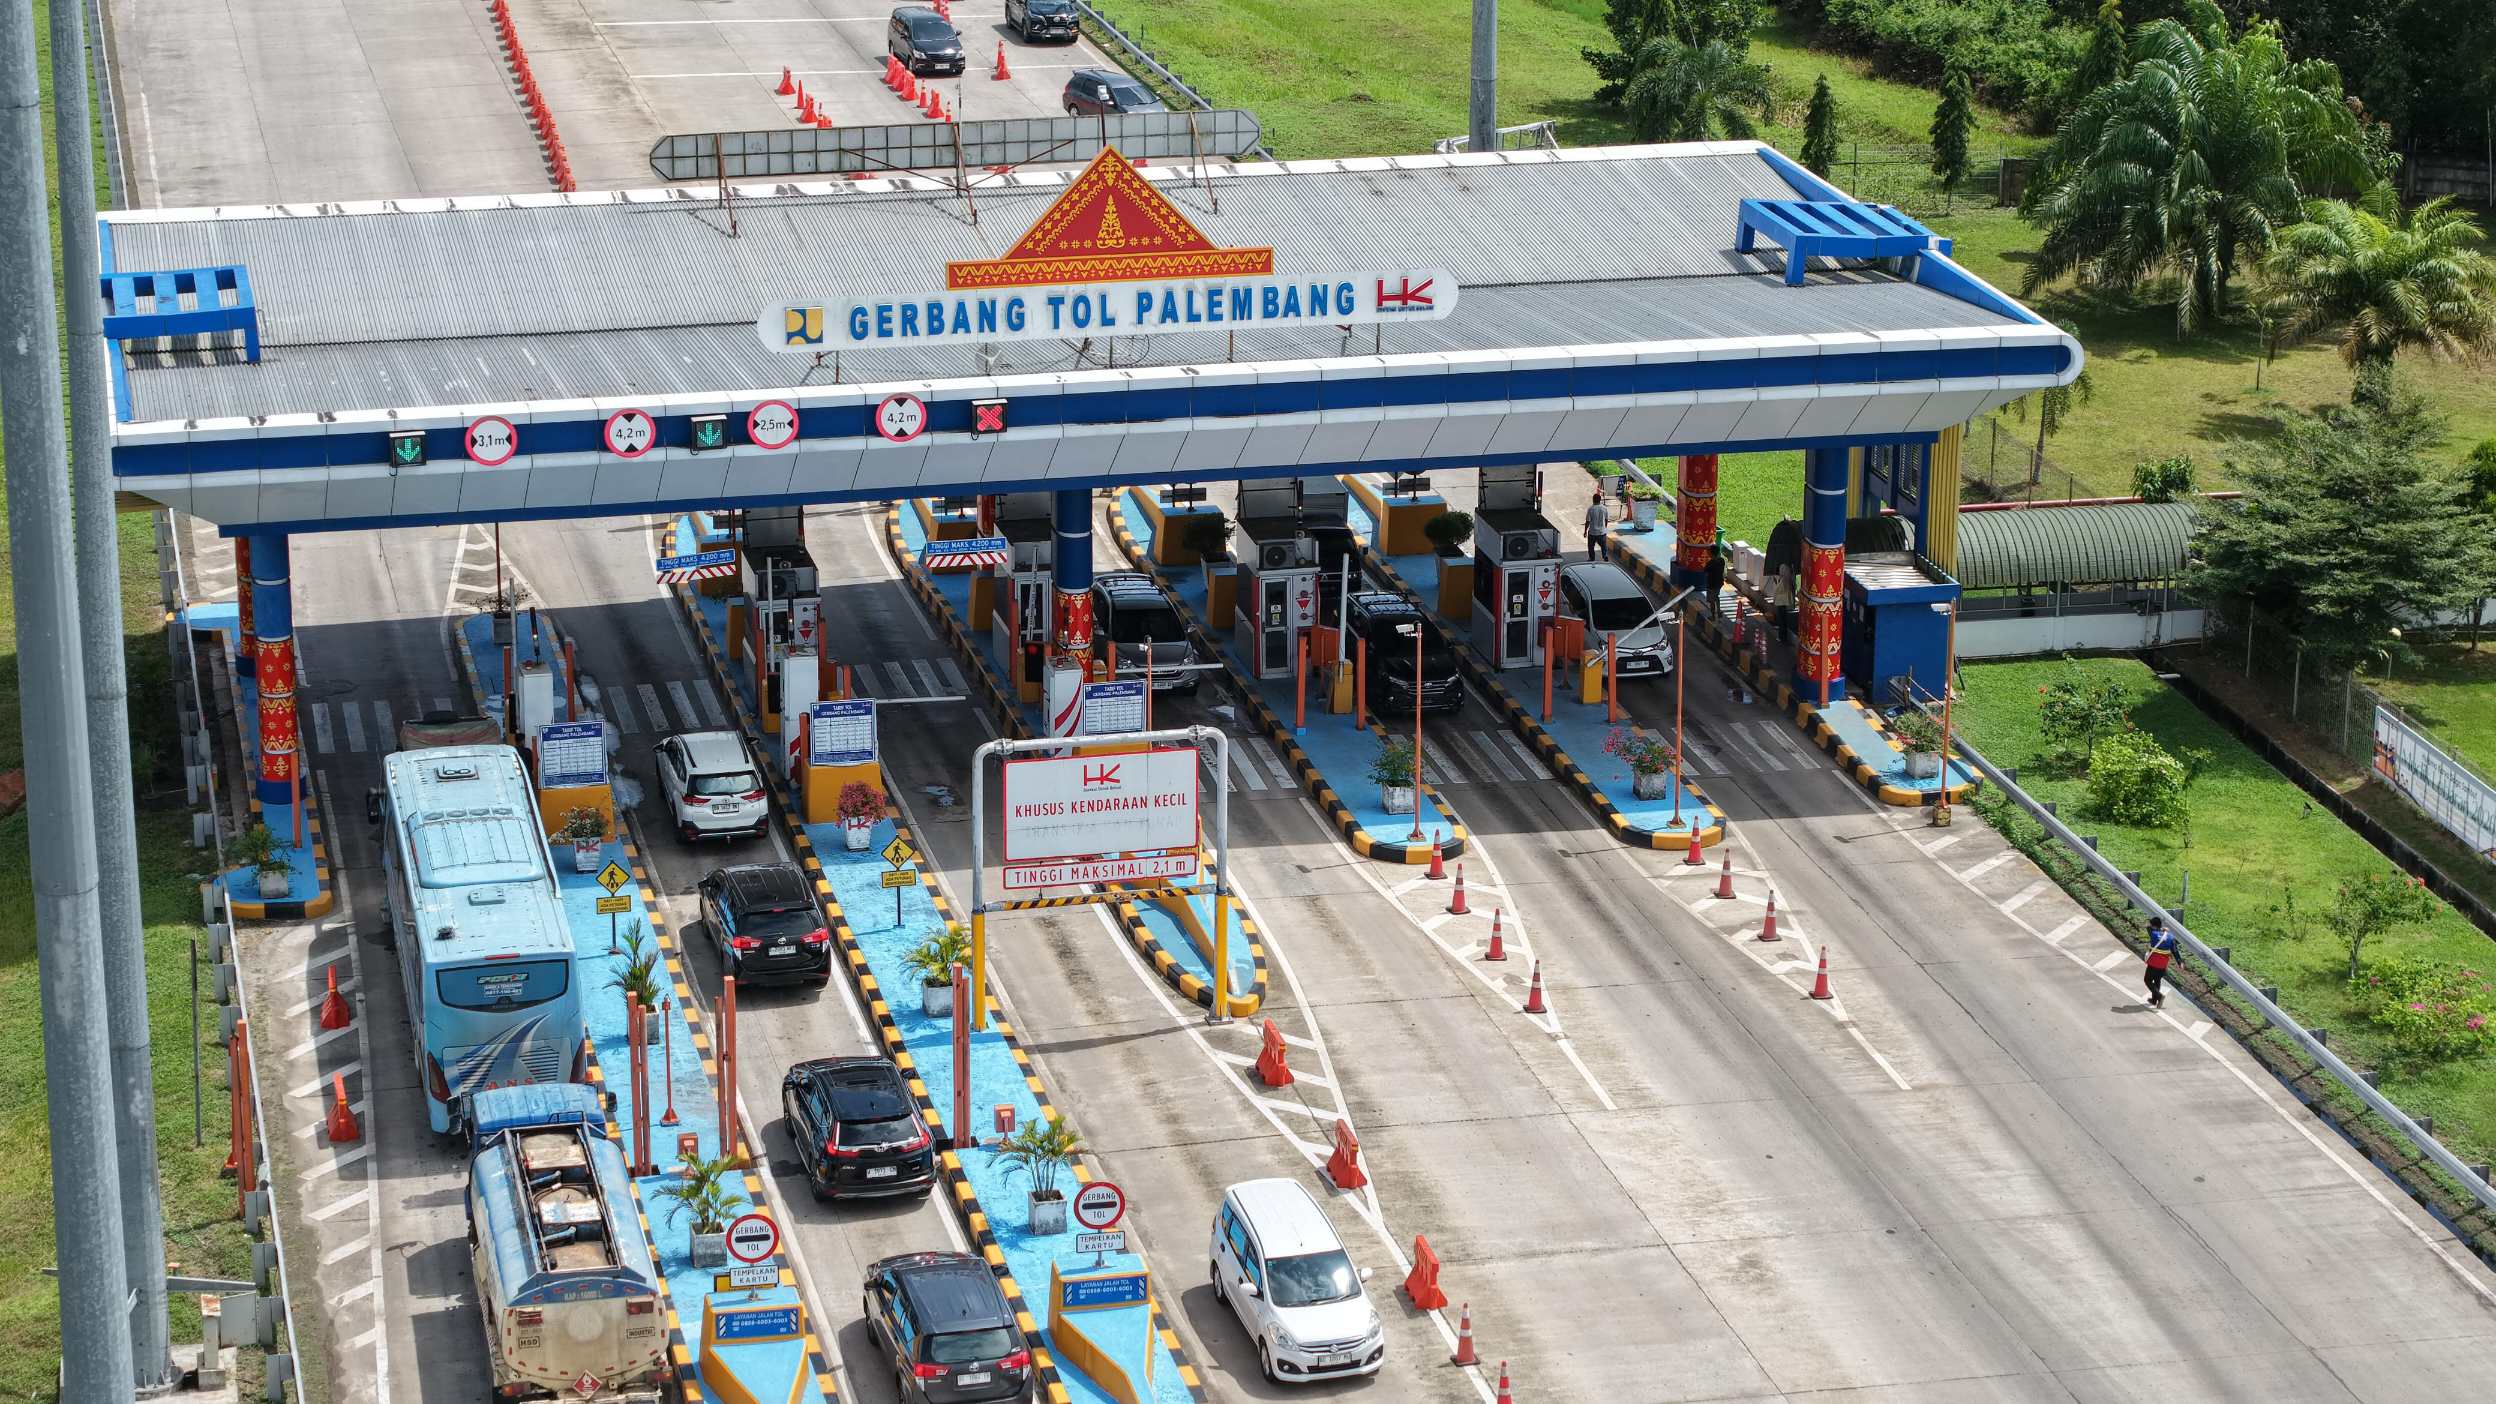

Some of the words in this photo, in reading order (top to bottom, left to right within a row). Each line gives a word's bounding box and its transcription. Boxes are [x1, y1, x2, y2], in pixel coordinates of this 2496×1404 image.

[850, 297, 1025, 341] GERBANG
[1048, 294, 1115, 329] TOL
[1136, 281, 1355, 325] PALEMBANG
[1015, 802, 1065, 818] KHUSUS
[1071, 796, 1148, 814] KENDARAAN
[1154, 792, 1187, 808] KECIL
[1015, 869, 1063, 884] TINGGI
[1071, 862, 1144, 880] MAKSIMAL
[1153, 861, 1169, 874] 2,1
[1175, 860, 1186, 872] m
[1082, 1192, 1116, 1201] GERBANG
[1093, 1211, 1105, 1219] TOL
[735, 1226, 769, 1235] GERBANG
[1081, 1234, 1121, 1243] TEMPELKAN
[747, 1243, 759, 1251] TOL
[1085, 1242, 1114, 1250] KARTU
[733, 1268, 776, 1276] TEMPELKAN
[739, 1276, 768, 1284] KARTU
